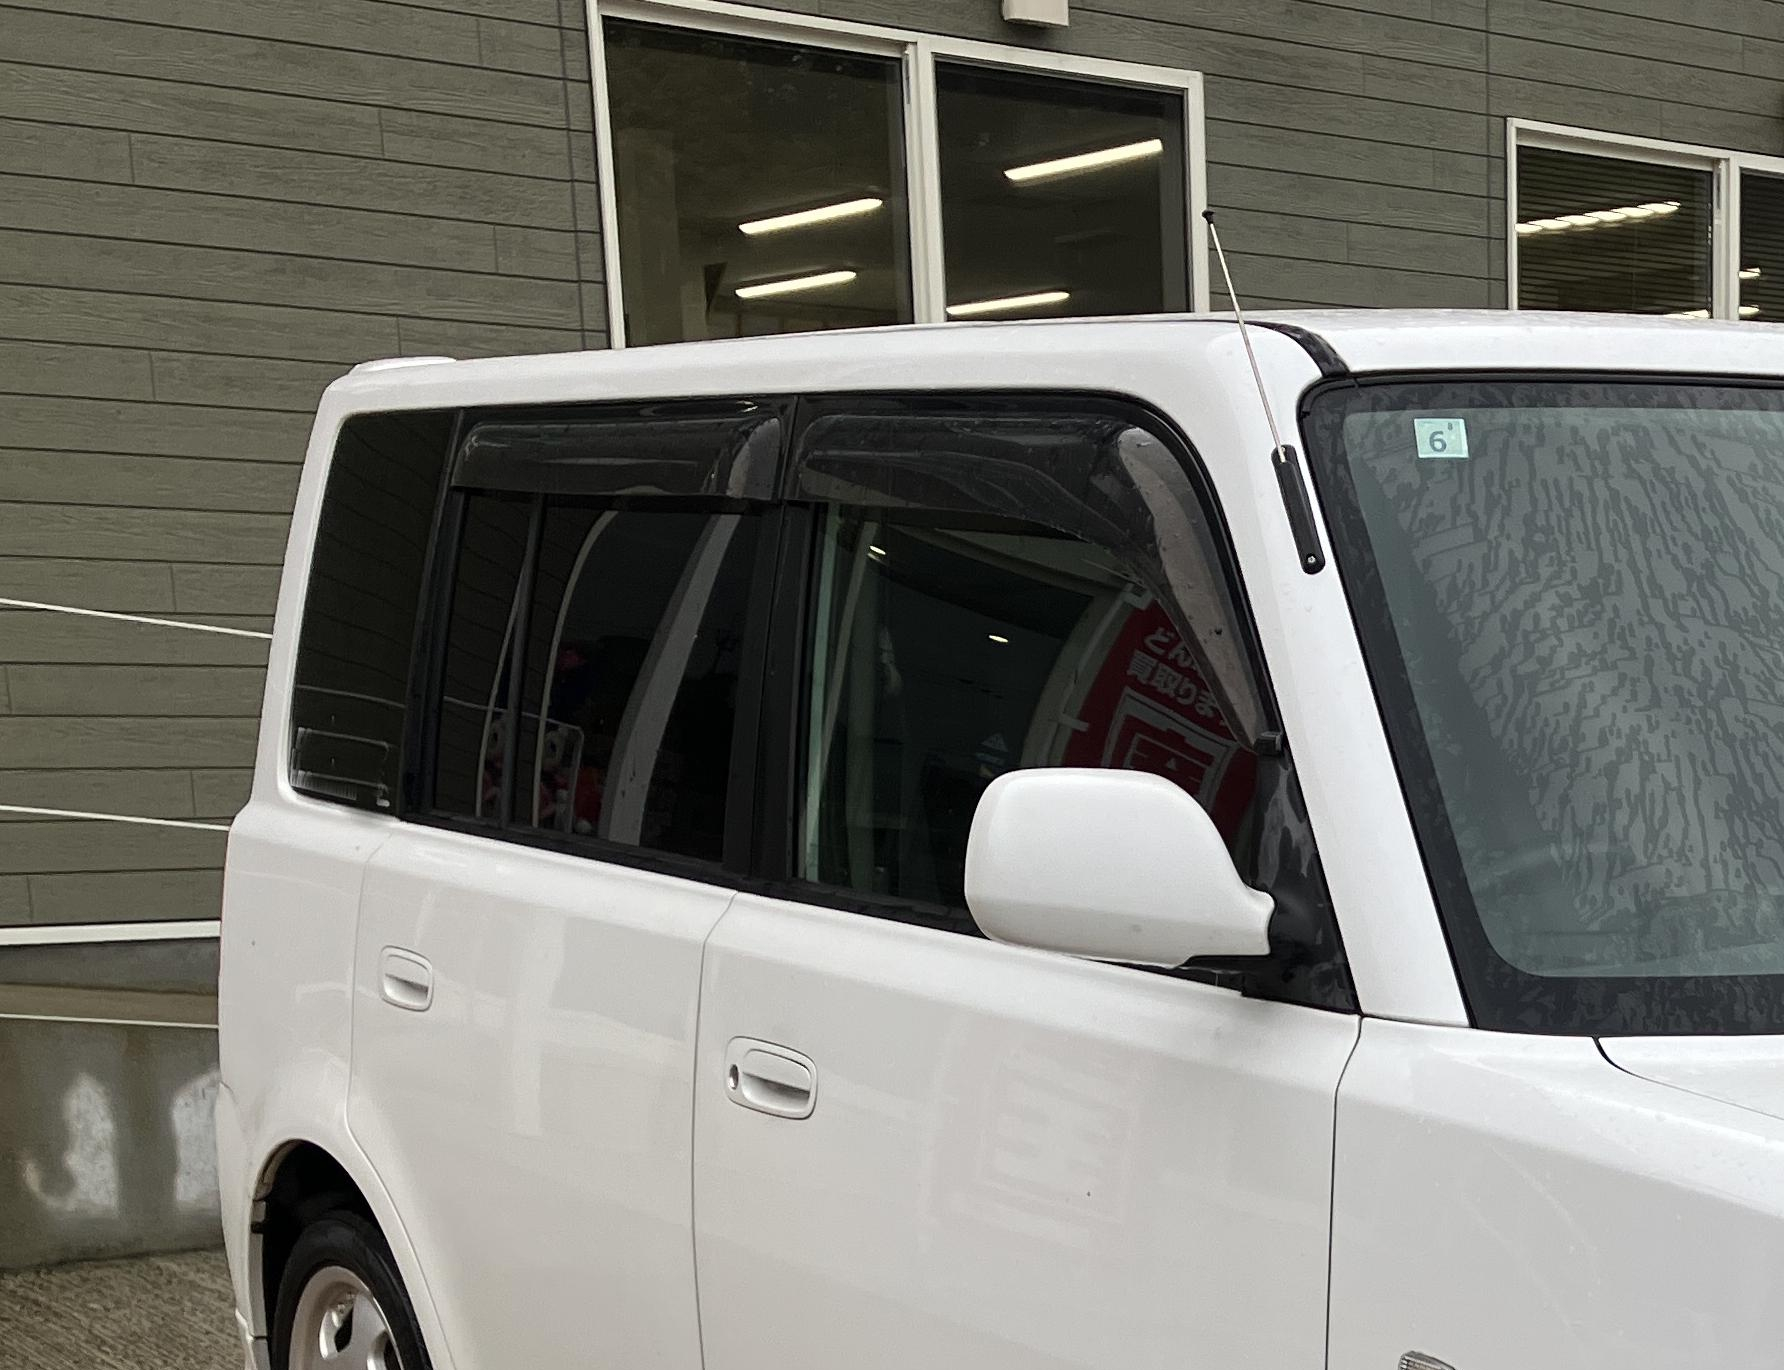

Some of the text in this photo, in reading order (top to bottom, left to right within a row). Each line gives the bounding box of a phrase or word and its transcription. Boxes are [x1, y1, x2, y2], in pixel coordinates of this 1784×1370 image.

[1429, 430, 1447, 452] 6
[1143, 626, 1197, 669] どん
[1127, 648, 1227, 726] 買取りま
